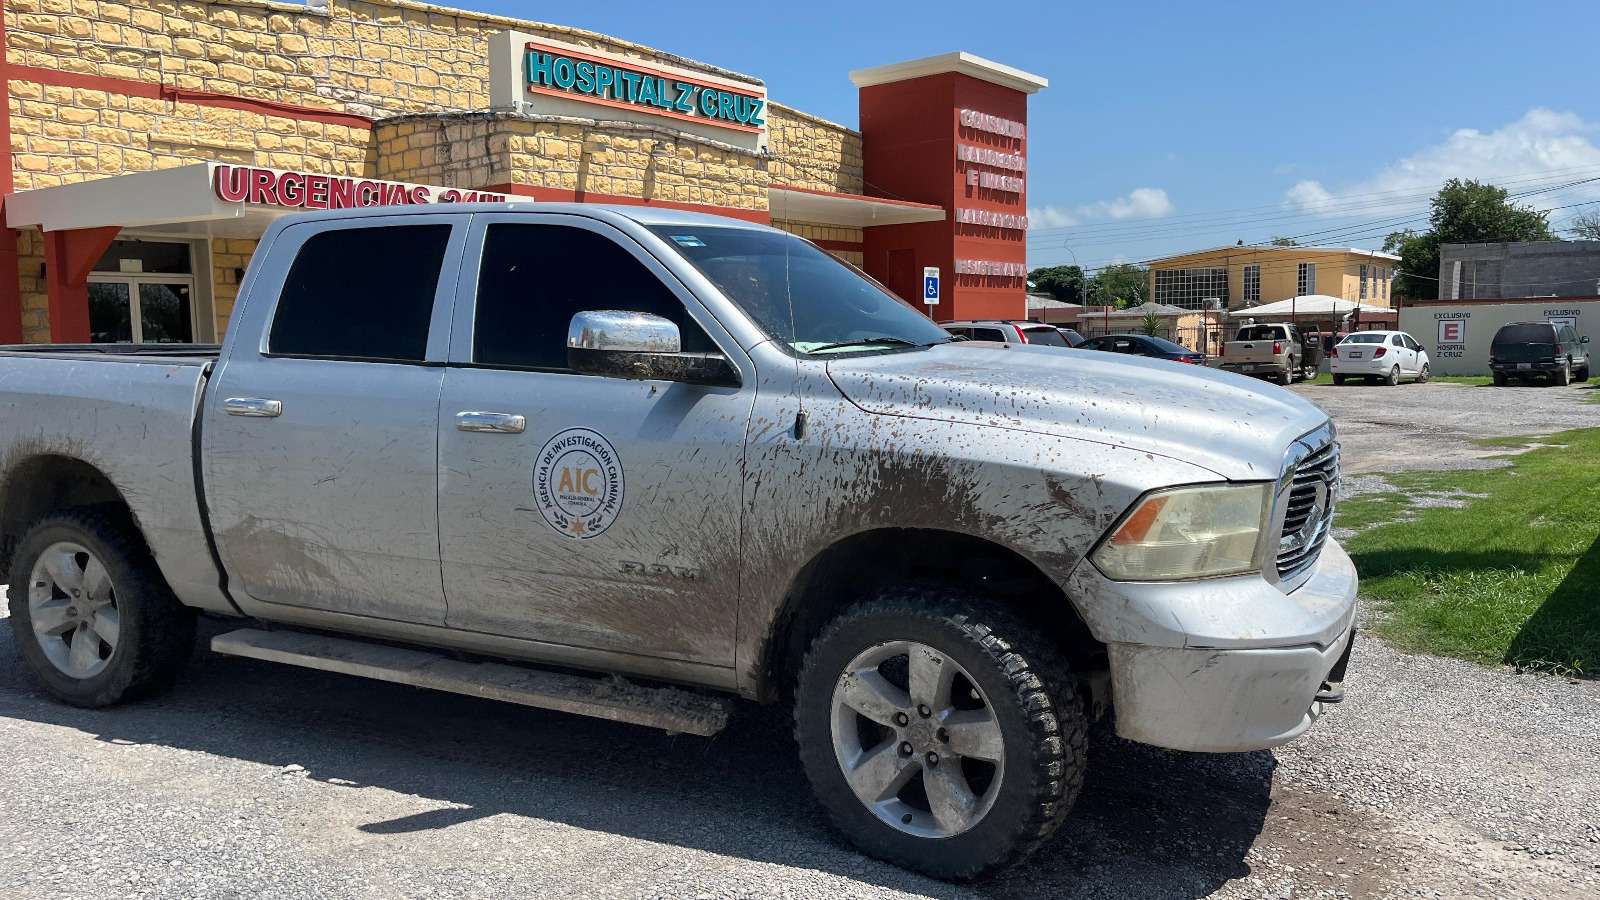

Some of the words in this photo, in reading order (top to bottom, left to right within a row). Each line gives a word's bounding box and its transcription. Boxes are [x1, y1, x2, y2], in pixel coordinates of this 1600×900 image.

[527, 50, 674, 108] HOSPITAL
[214, 165, 430, 209] URGENCIAS
[1543, 309, 1581, 317] EXCLUSIVO
[1444, 324, 1459, 340] E
[544, 451, 555, 466] DE
[552, 435, 613, 466] INVESTIGACIÓN
[539, 466, 553, 509] AGENCIA
[559, 465, 599, 496] AIC
[603, 466, 618, 515] CRIMINAL
